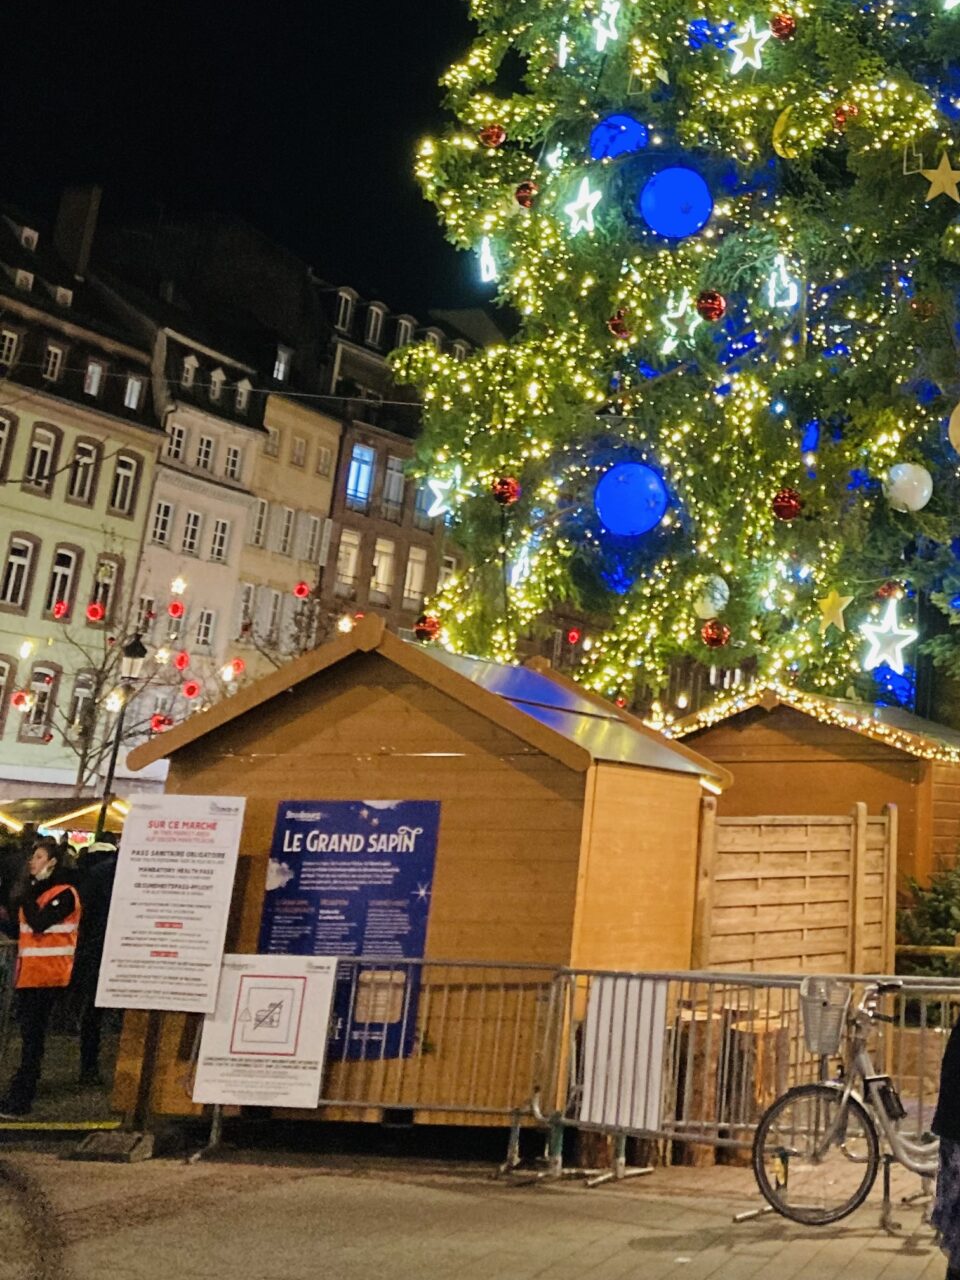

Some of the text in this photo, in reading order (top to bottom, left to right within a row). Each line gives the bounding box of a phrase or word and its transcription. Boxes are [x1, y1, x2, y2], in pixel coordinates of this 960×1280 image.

[147, 820, 166, 829] SUR
[168, 821, 179, 829] CE
[282, 825, 424, 853] LE GRAND SAPIN
[131, 849, 149, 857] PASS
[150, 850, 185, 858] SANITAIRE
